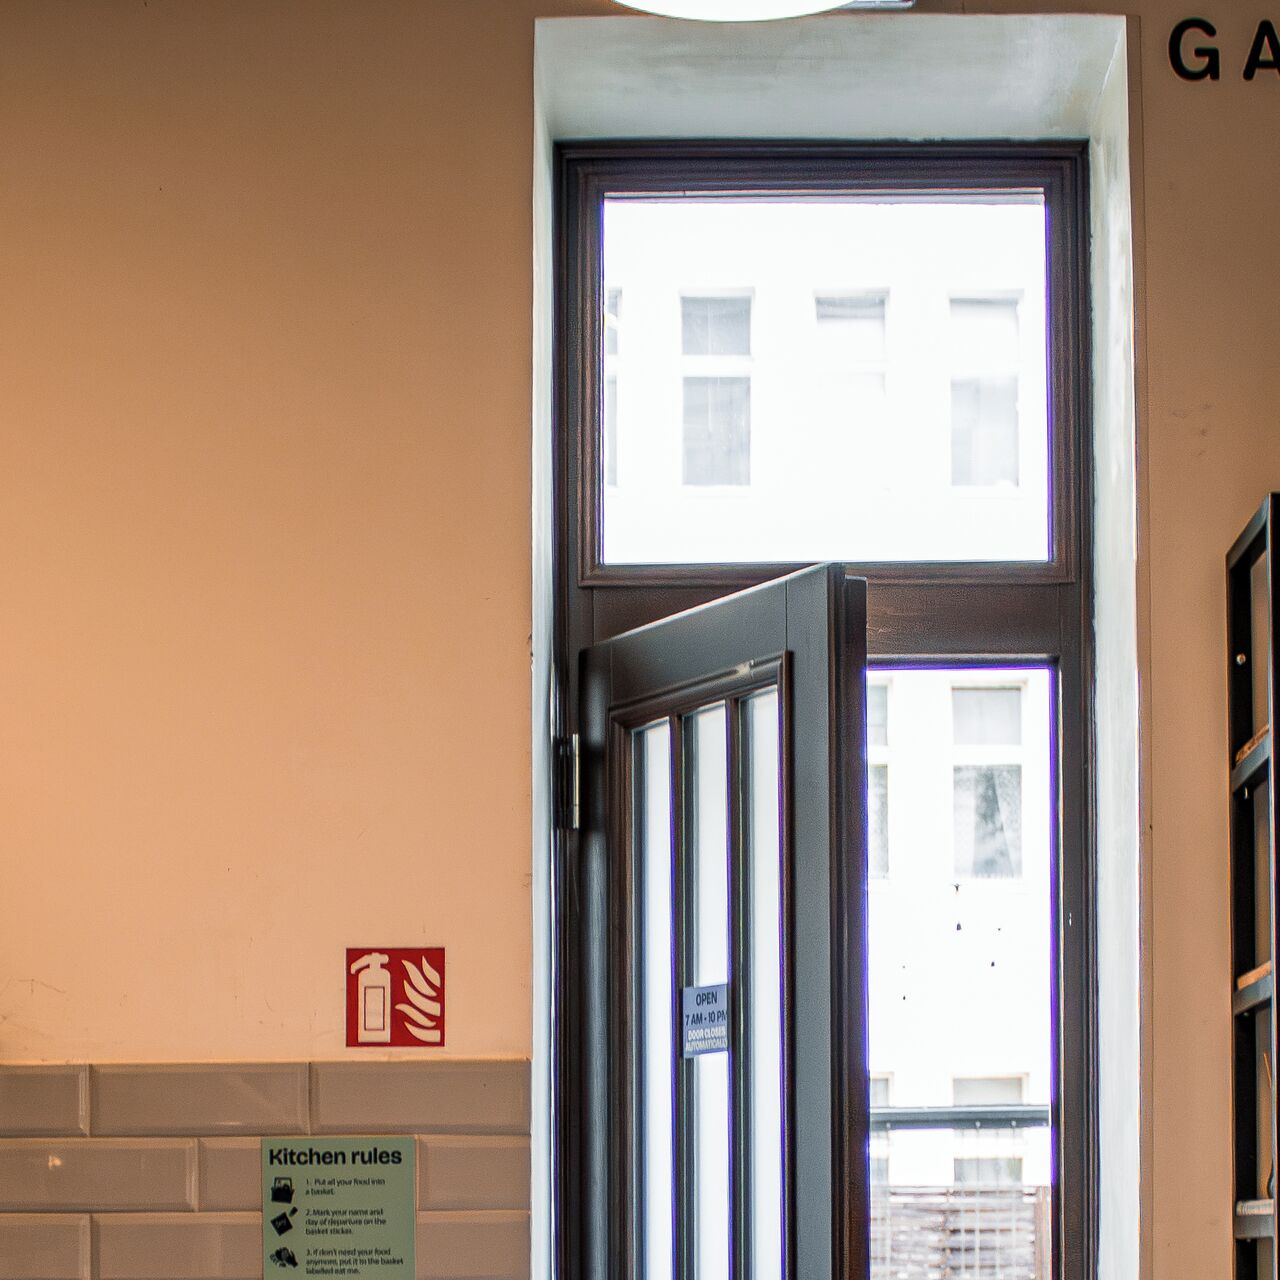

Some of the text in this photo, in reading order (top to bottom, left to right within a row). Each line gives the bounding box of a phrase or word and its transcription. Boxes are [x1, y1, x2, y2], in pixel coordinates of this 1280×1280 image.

[696, 991, 718, 1006] OPEN
[685, 1014, 690, 1026] 7
[691, 1012, 703, 1025] AM
[708, 1010, 716, 1023] 10
[270, 1147, 402, 1166] Kitchen rules
